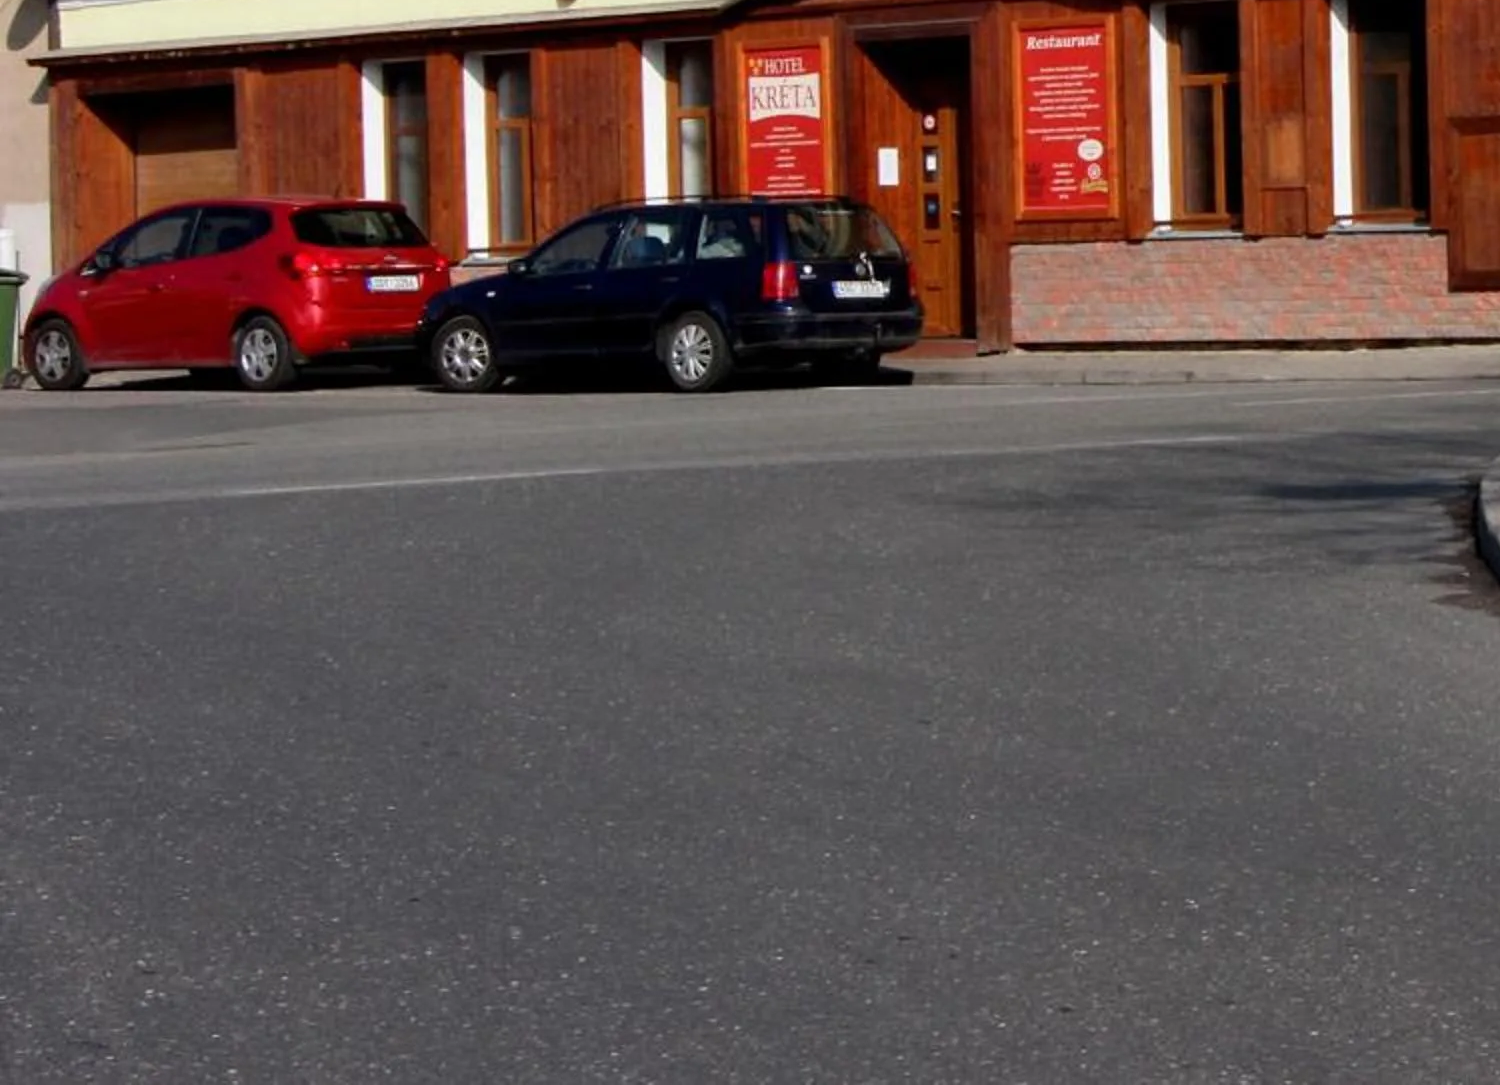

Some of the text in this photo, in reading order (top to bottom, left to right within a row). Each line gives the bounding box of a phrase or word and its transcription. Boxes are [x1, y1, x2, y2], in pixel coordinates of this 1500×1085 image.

[1026, 34, 1101, 50] Restaurant
[764, 57, 806, 75] HOTEL
[752, 79, 816, 110] KRÉTA
